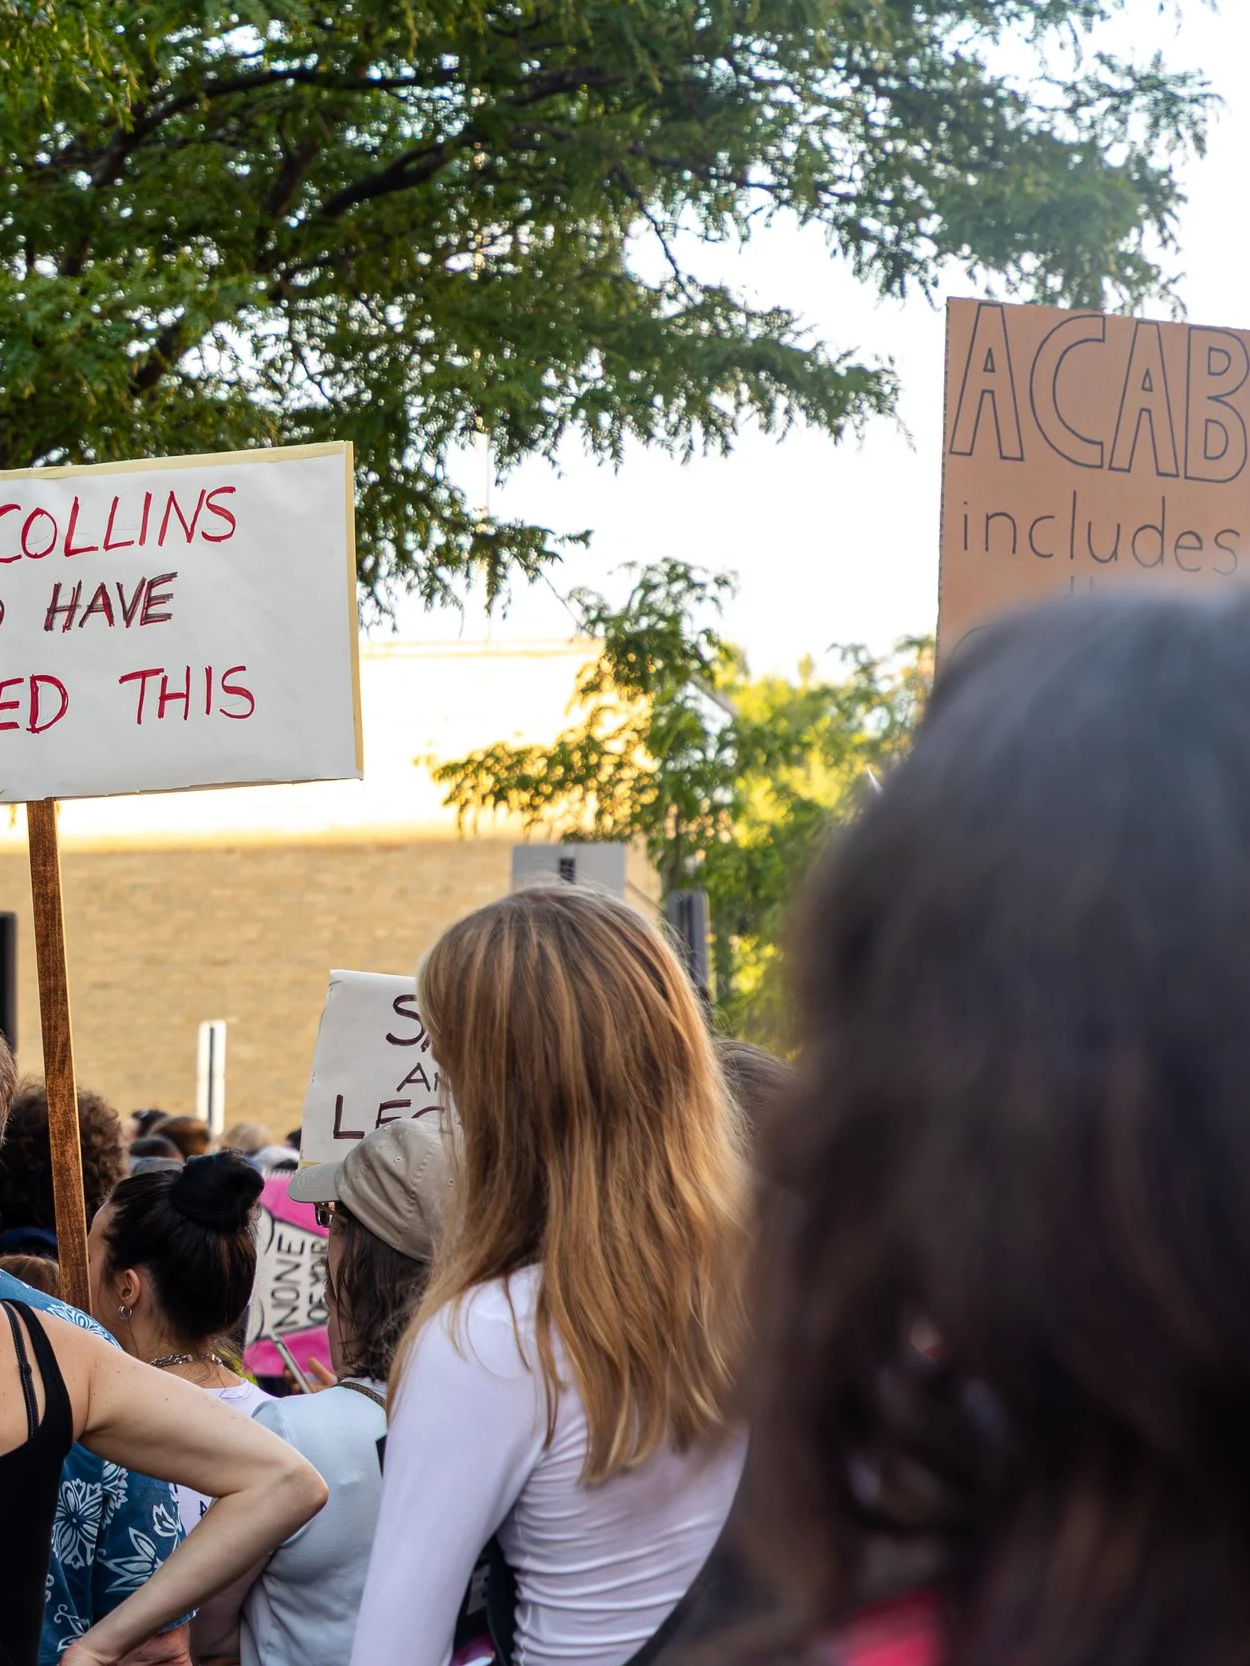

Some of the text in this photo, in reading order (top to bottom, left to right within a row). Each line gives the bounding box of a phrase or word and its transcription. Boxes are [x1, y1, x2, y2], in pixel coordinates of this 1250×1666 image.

[949, 302, 1250, 483] ACAB
[963, 490, 1240, 576] includes
[44, 571, 179, 633] HAVE
[118, 665, 256, 724] THIS
[385, 994, 431, 1052] S
[270, 1232, 306, 1329] NONE
